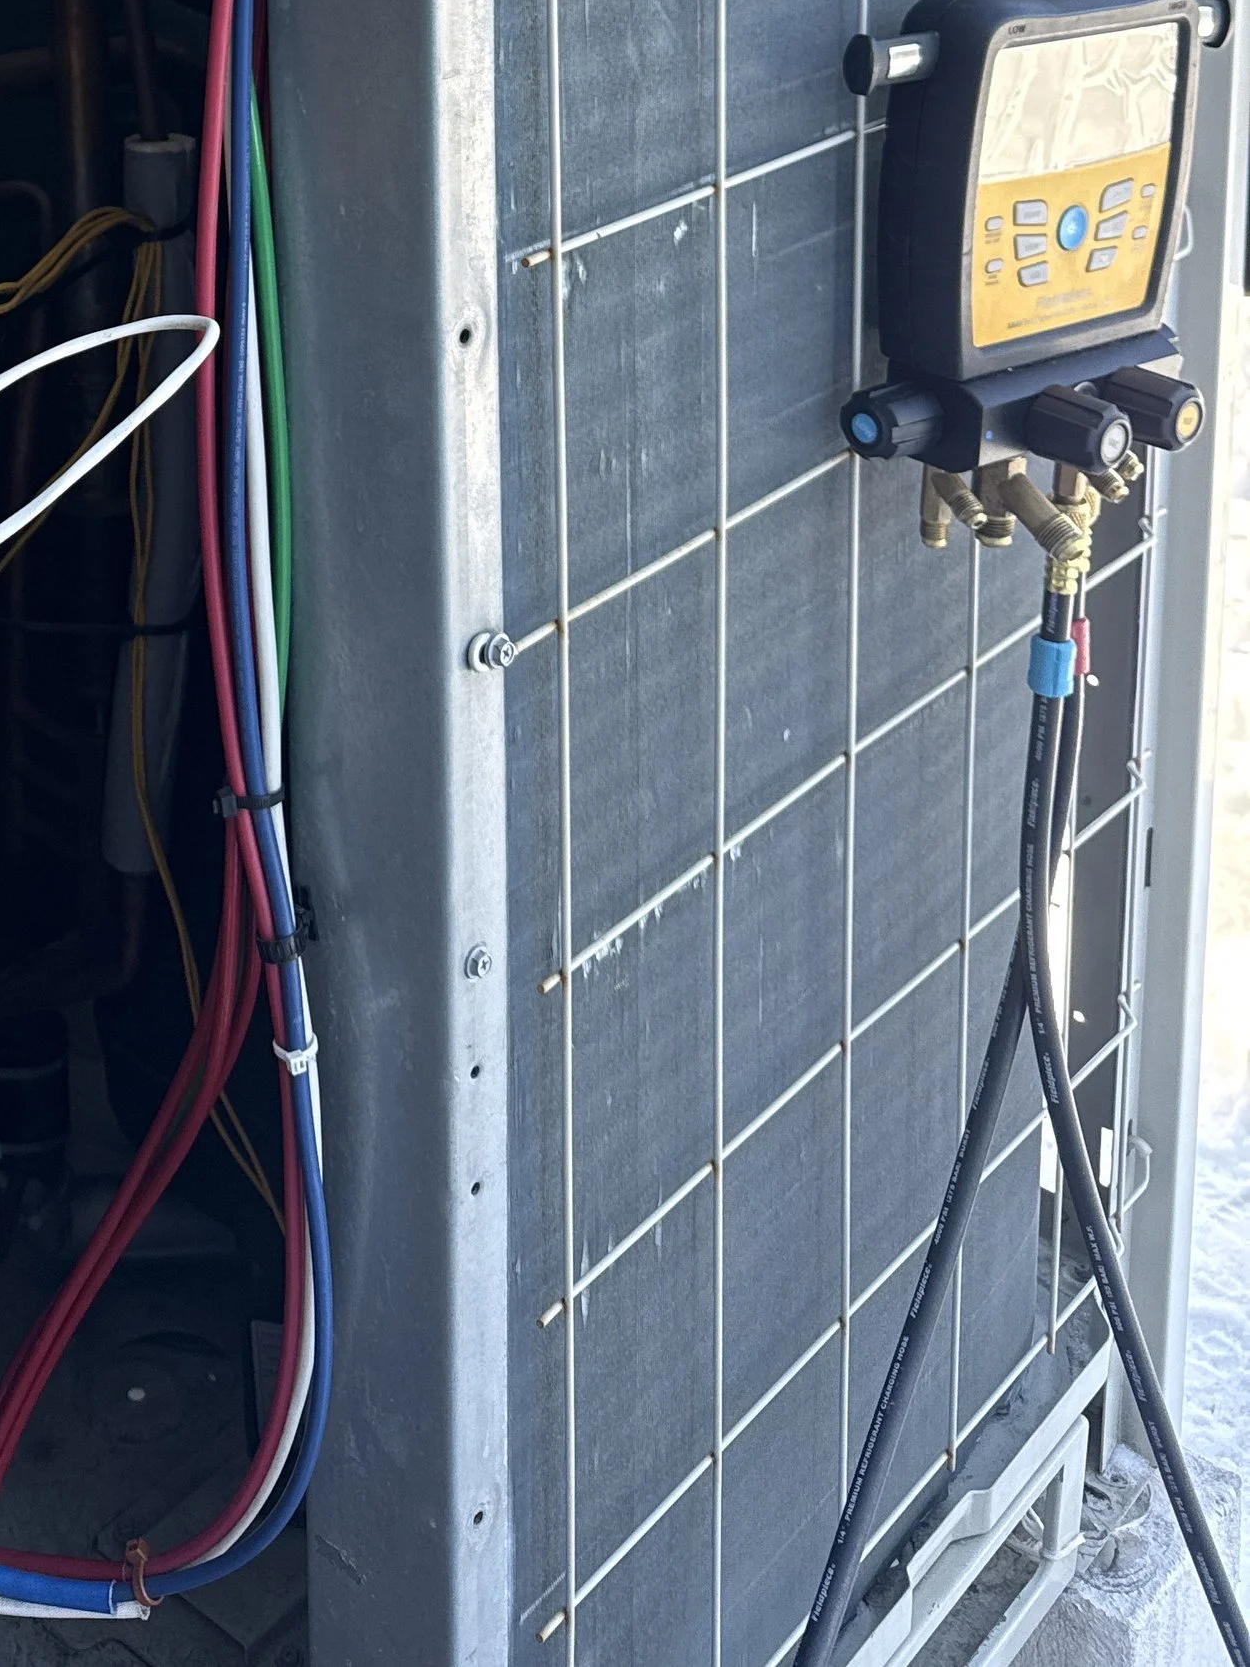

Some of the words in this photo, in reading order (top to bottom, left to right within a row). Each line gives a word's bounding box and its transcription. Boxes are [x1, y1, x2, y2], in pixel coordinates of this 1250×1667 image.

[1007, 23, 1027, 36] LOW
[1026, 778, 1039, 827] Fieldpiece
[1024, 842, 1035, 866] HOSE
[1023, 867, 1034, 911] CHARGING
[1020, 912, 1039, 972] REFRIGERANT
[1026, 972, 1043, 1016] PREMIUM
[1041, 1053, 1060, 1104] Fieldpiece
[932, 1222, 945, 1245] 4000
[939, 1205, 951, 1222] PSI
[957, 1127, 972, 1159] BURST
[1090, 1240, 1102, 1262] MAX
[907, 1265, 934, 1319] Fieldpiece
[1122, 1351, 1148, 1404] Fieldpiece
[842, 1476, 864, 1522] PREMIUM
[856, 1410, 886, 1476] REFRIGERANT
[877, 1360, 904, 1410] CHARGING
[895, 1334, 910, 1360] HOSE
[811, 1565, 835, 1623] Fieldpiece
[1194, 1553, 1222, 1606] Fieldpiece
